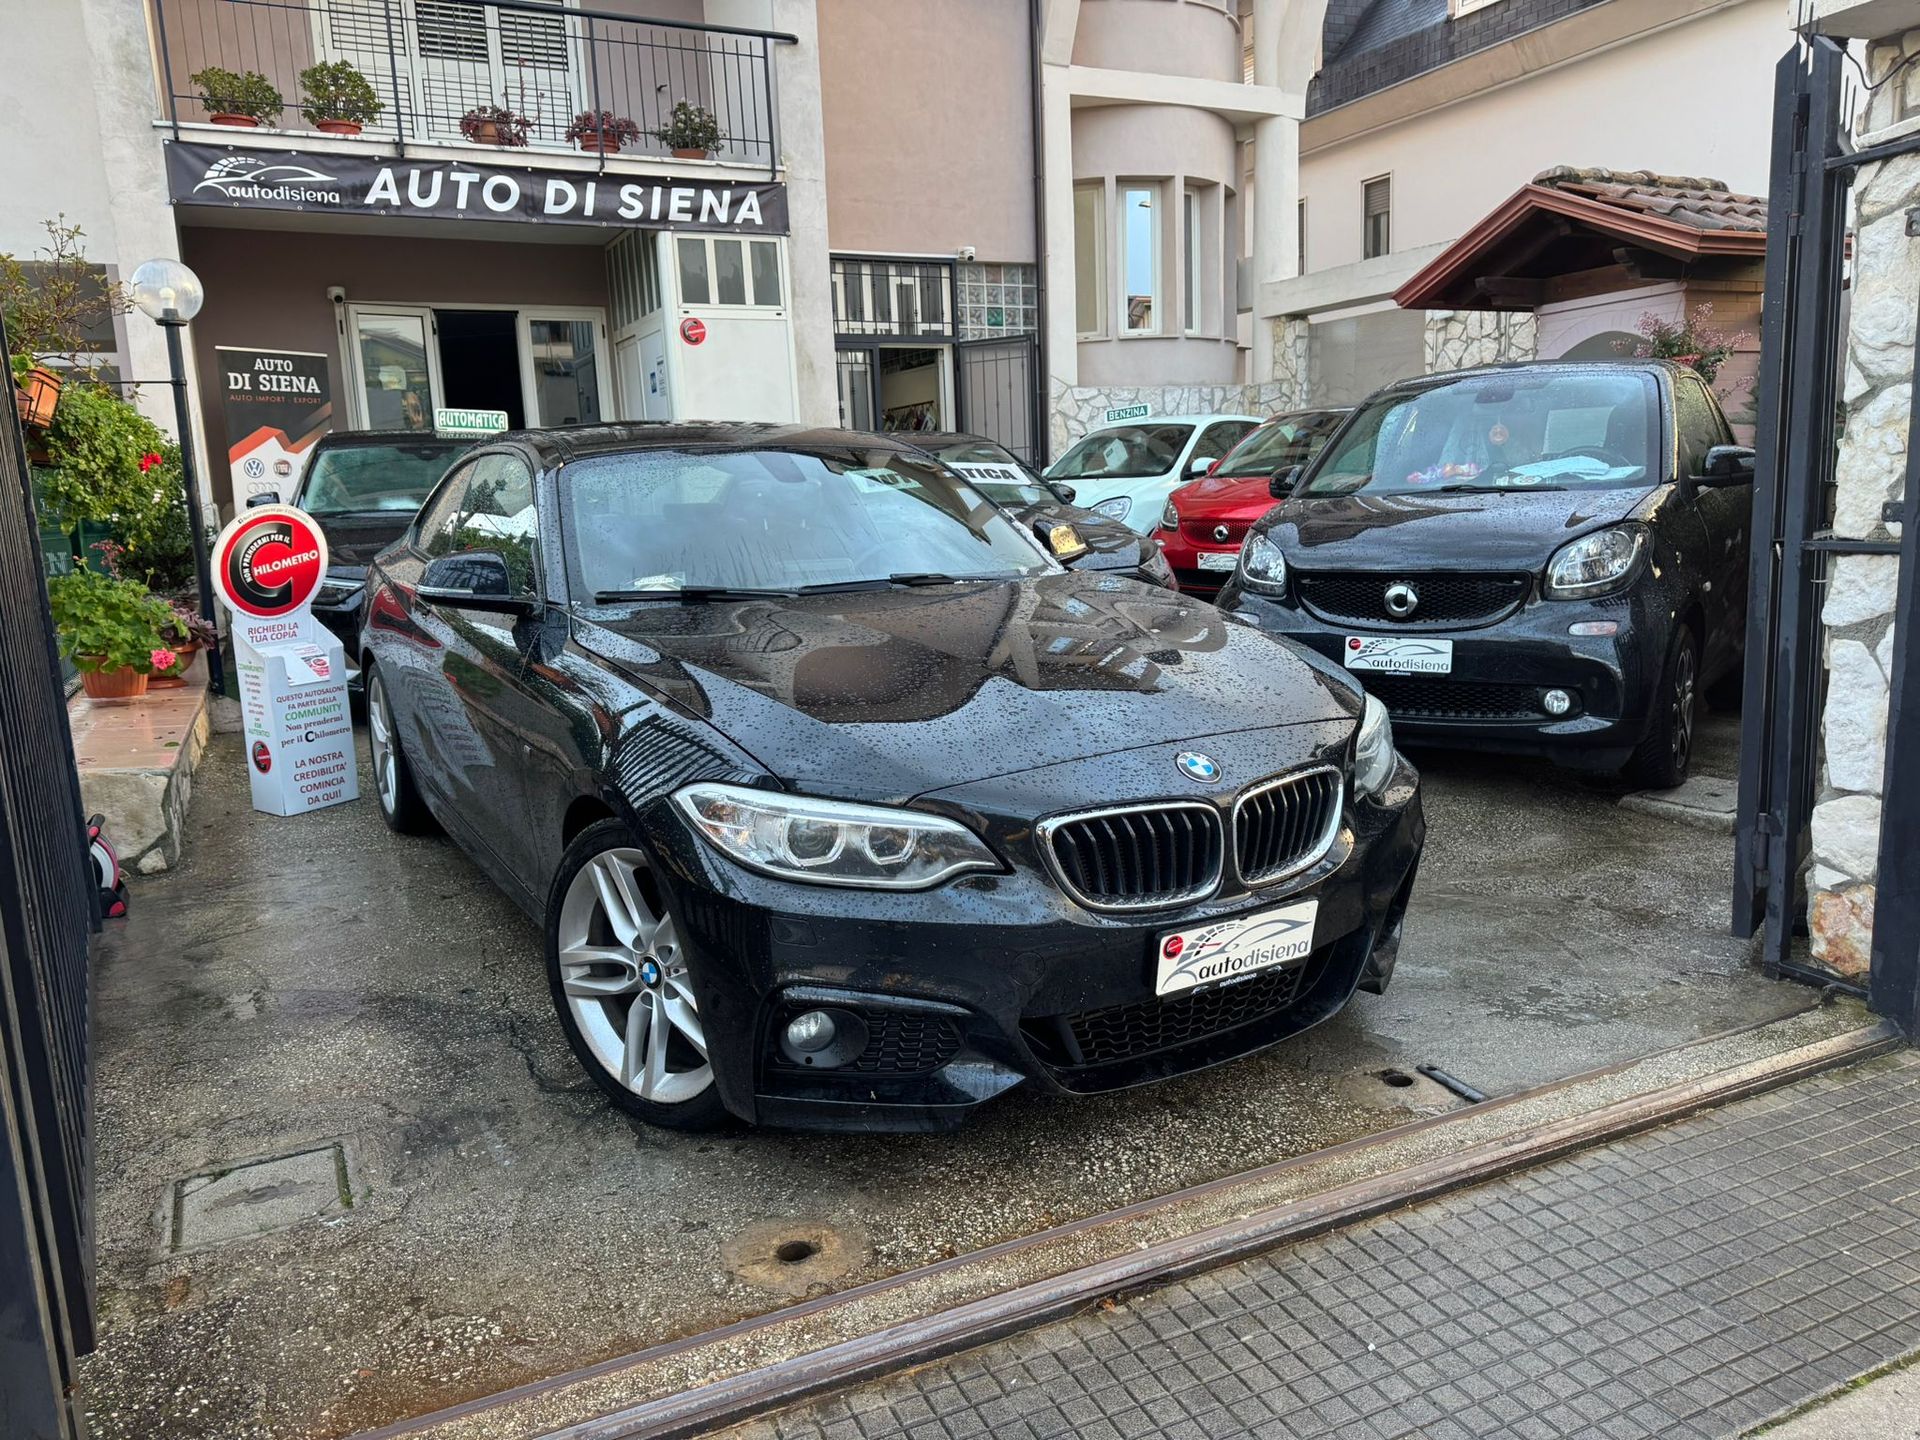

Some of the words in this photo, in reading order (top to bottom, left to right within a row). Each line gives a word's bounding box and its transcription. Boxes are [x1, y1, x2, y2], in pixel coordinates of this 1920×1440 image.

[227, 184, 341, 205] autodisiena
[364, 167, 521, 213] AUTO
[543, 179, 596, 217] DI
[616, 183, 763, 225] SIENA
[254, 358, 293, 373] AUTO
[228, 372, 252, 390] DI
[259, 374, 321, 393] SIENA
[230, 394, 252, 402] AUTO
[256, 395, 286, 403] IMPORT
[439, 411, 506, 428] AUTOMATICA
[1108, 406, 1146, 420] BENZINA
[270, 534, 283, 542] PER
[284, 536, 291, 544] IL
[243, 535, 270, 567] PRENDERMI
[242, 568, 253, 583] NON
[247, 624, 286, 636] RICHIEDI
[288, 622, 299, 630] LA
[250, 634, 269, 643] TUA
[270, 630, 297, 641] COPIA
[1372, 658, 1449, 672] autodisiena
[276, 693, 303, 703] QUESTO
[304, 685, 345, 698] AUTOSALONE
[297, 699, 316, 709] PARTE
[318, 695, 337, 704] DELLA
[285, 703, 342, 721] COMMUNITY
[285, 723, 302, 732] Non
[303, 714, 344, 731] prendermi
[281, 738, 295, 749] per
[297, 734, 303, 743] il
[305, 727, 351, 742] Chilometro
[294, 759, 307, 769] LA
[308, 751, 344, 766] NOSTRA
[293, 761, 347, 782] CREDIBILITA'
[299, 776, 346, 794] COMINCIA
[307, 796, 320, 806] DA
[322, 789, 342, 801] QUI!
[1198, 939, 1309, 979] autodisiena
